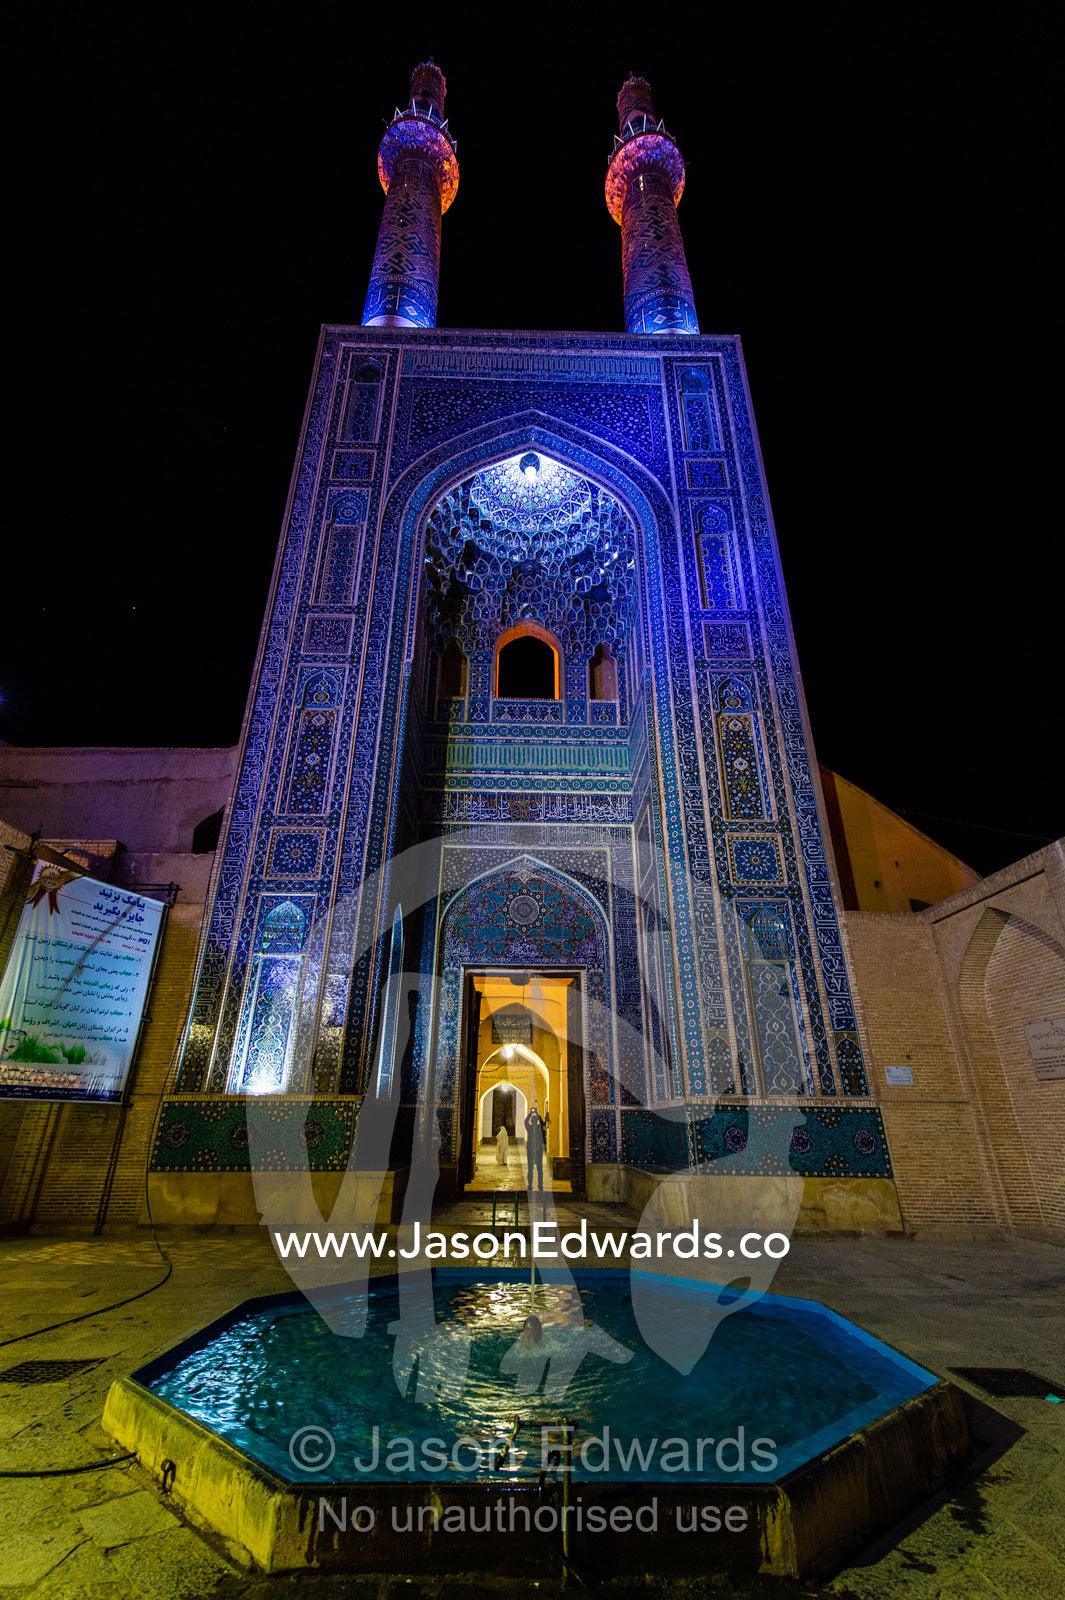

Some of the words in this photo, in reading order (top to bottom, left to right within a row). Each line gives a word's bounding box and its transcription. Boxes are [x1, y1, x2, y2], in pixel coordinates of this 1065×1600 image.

[99, 889, 120, 904] بزنید
[122, 896, 146, 912] پیامک
[93, 902, 120, 920] بگیرید
[122, 911, 144, 926] جایزه
